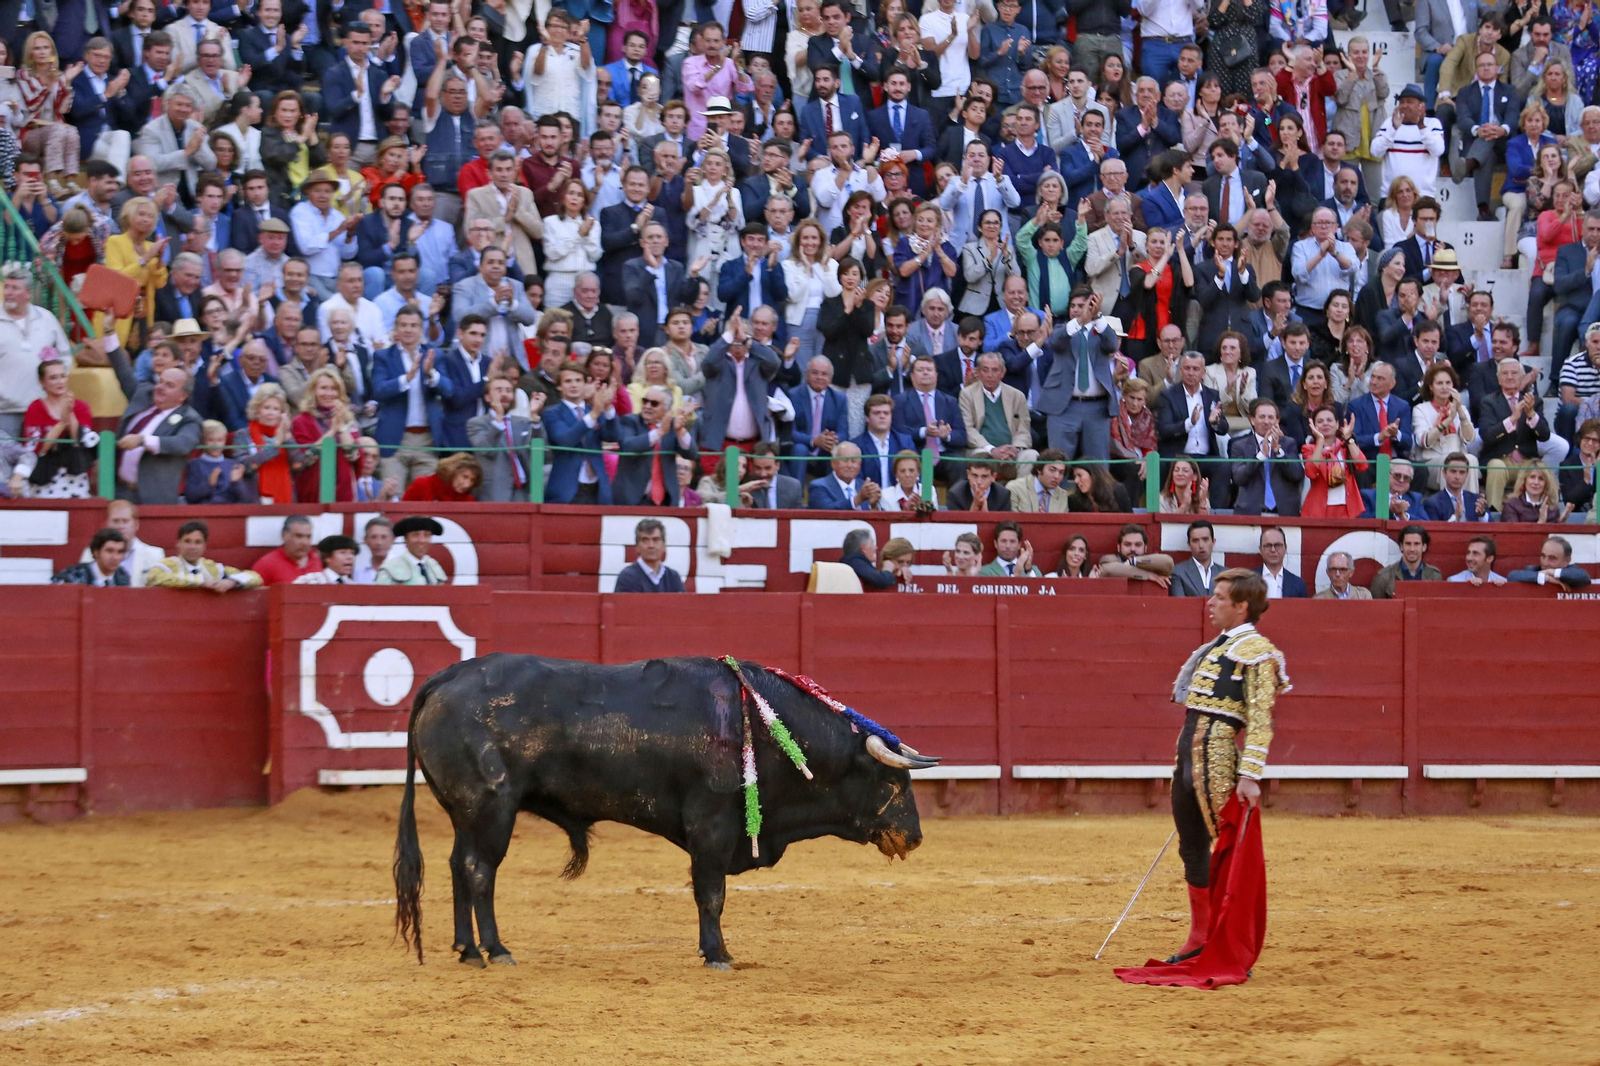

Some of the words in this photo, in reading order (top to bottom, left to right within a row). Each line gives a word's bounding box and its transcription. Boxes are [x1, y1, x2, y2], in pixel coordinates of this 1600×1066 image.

[1440, 188, 1450, 202] 9
[1464, 232, 1473, 246] 8
[937, 583, 959, 594] DEL
[972, 584, 1029, 596] GOBIERNO
